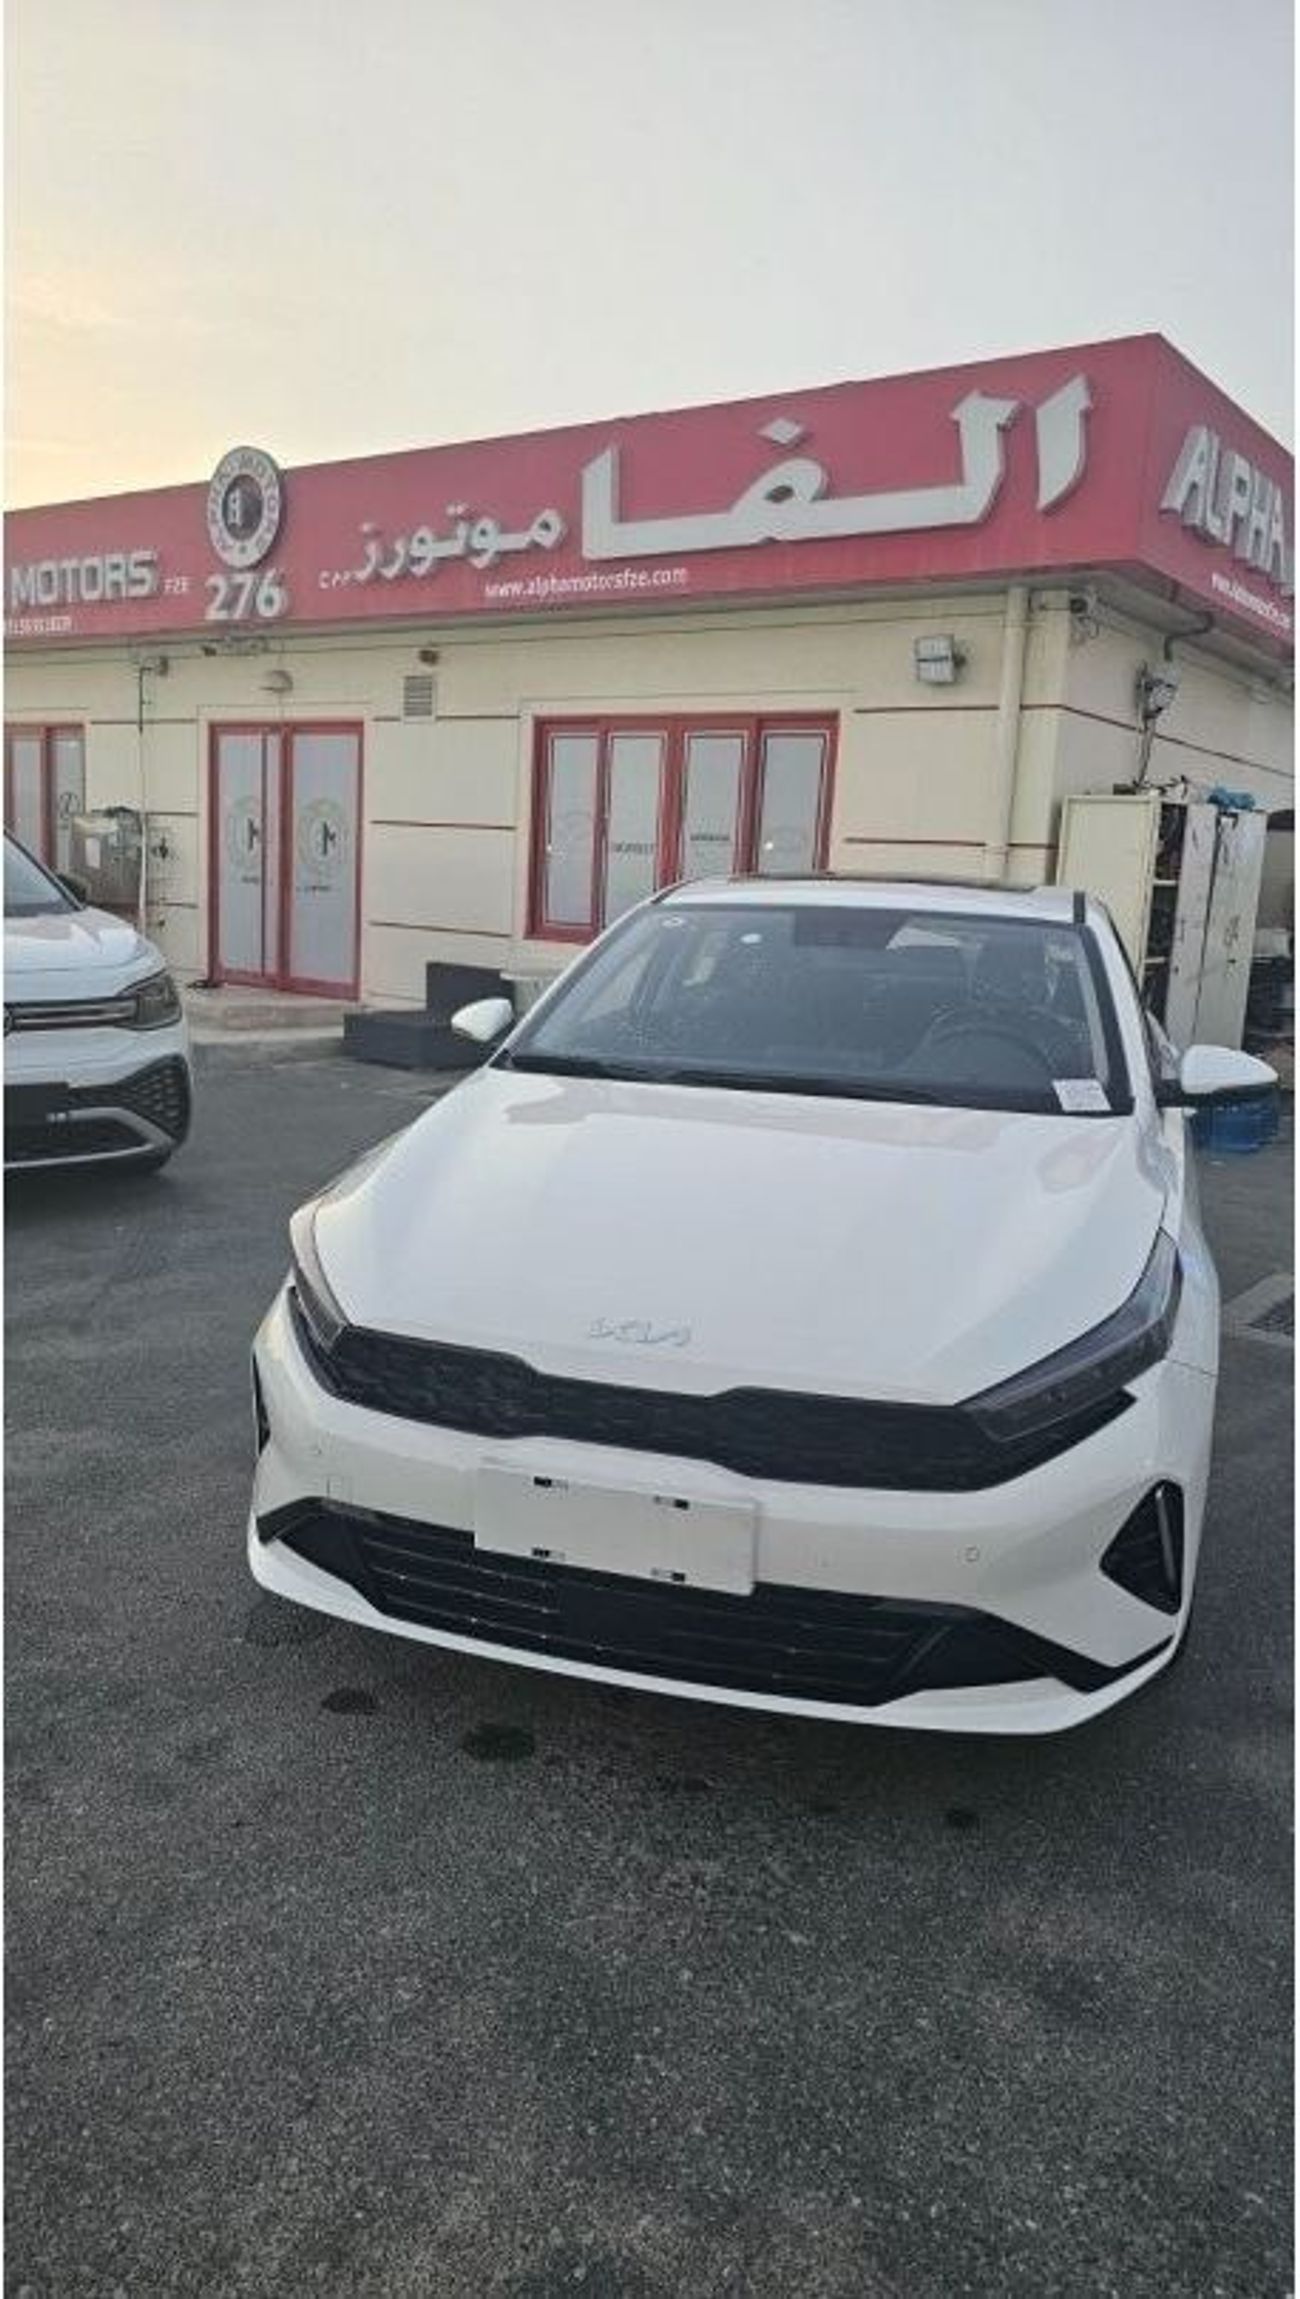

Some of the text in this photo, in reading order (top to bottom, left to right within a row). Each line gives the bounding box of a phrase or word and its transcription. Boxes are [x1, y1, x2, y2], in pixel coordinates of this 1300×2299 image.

[581, 374, 1093, 561] الفا
[353, 502, 566, 581] موتورز
[1160, 424, 1295, 596] ALPHA
[11, 551, 157, 606] MOTORS
[204, 568, 285, 620] 276
